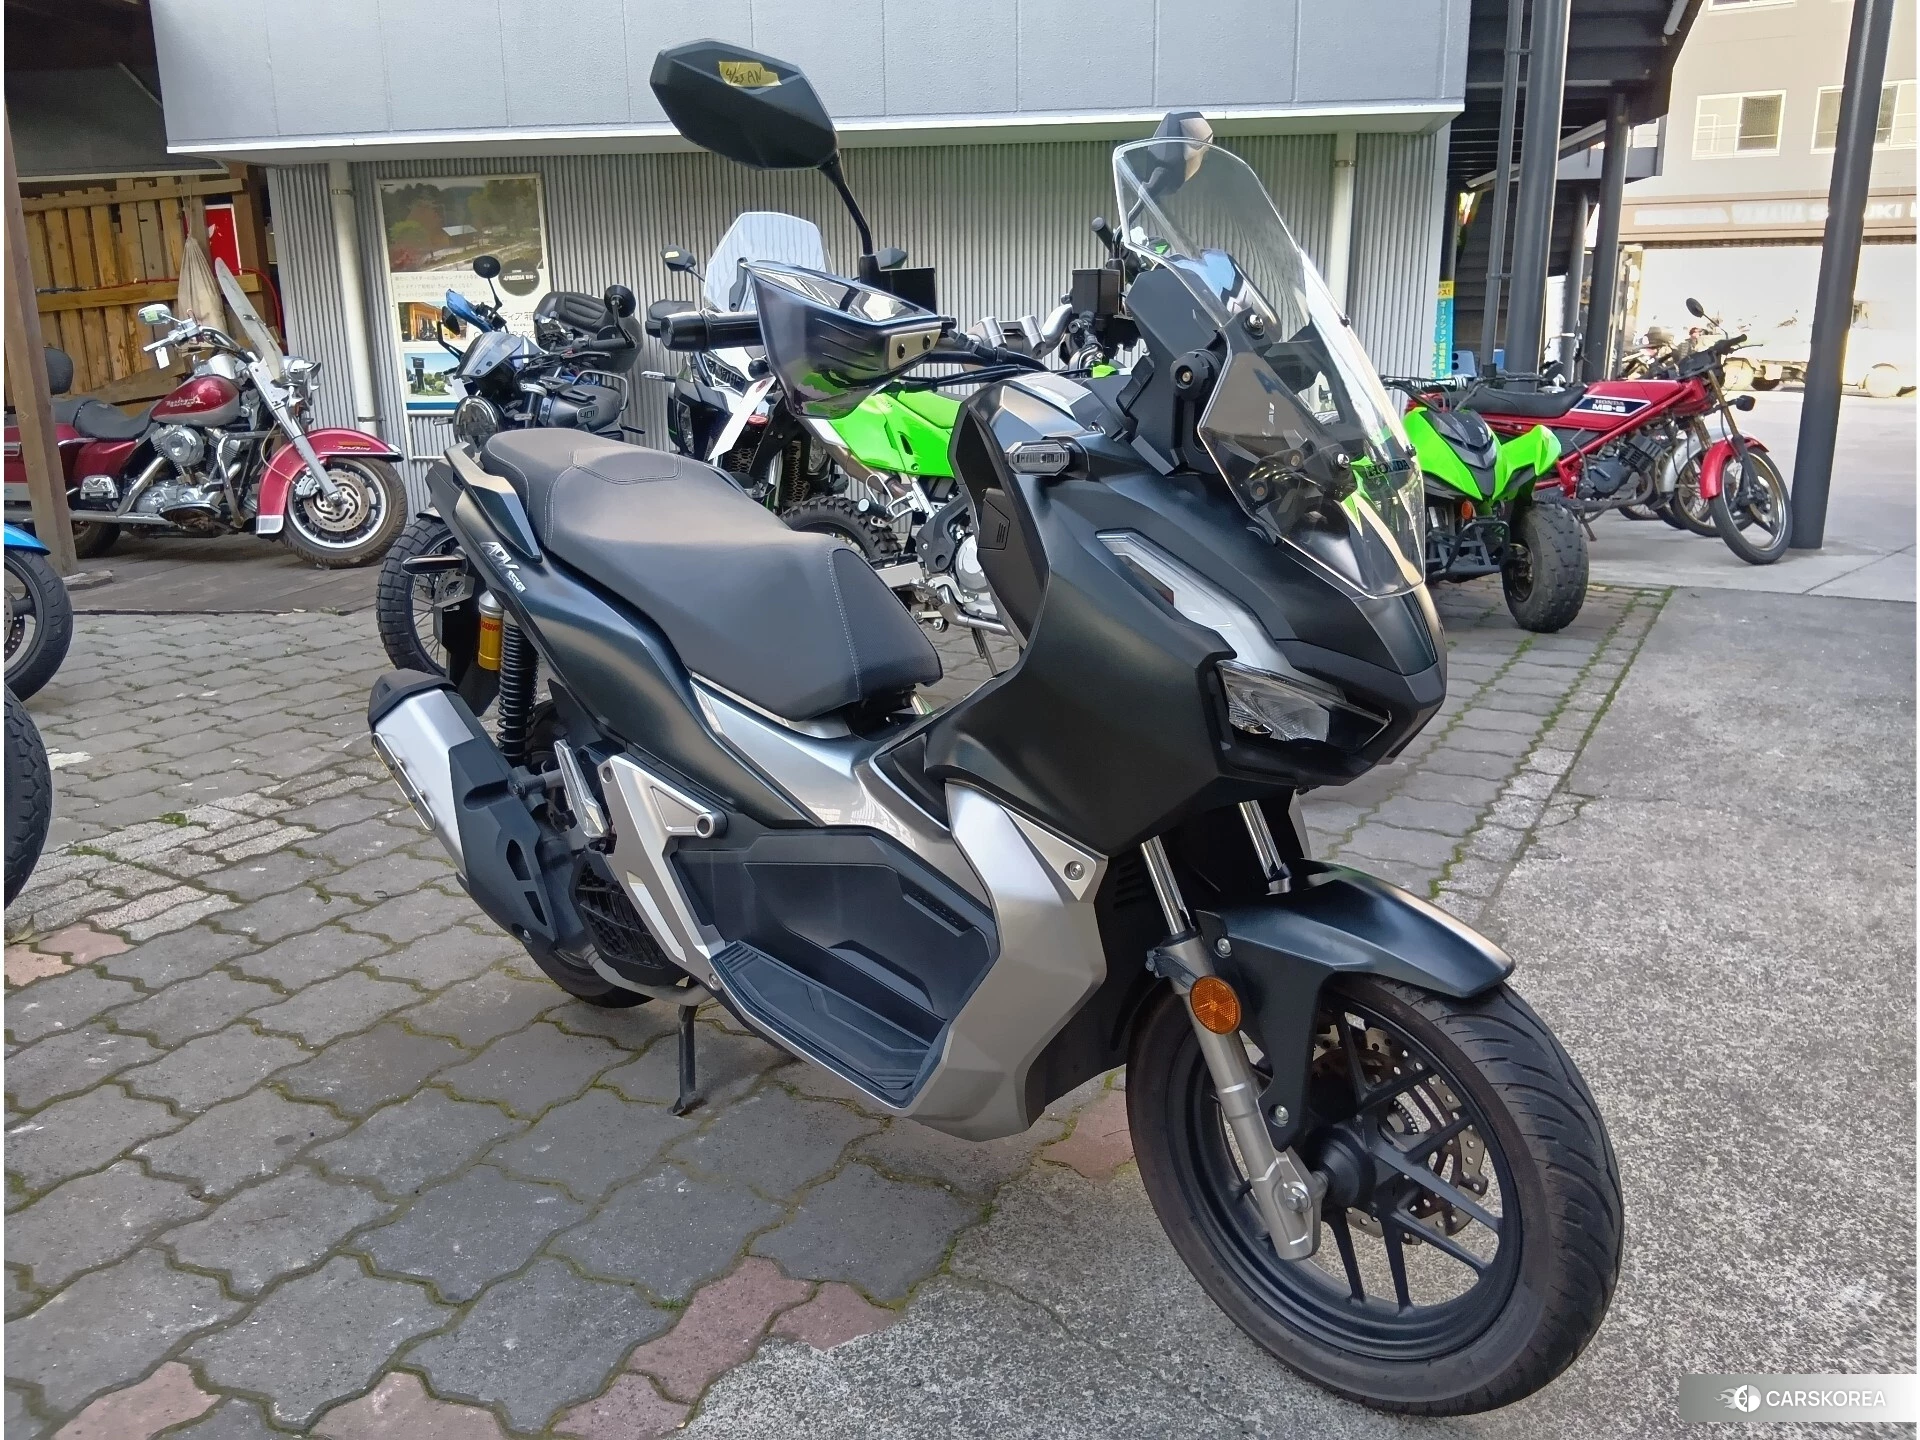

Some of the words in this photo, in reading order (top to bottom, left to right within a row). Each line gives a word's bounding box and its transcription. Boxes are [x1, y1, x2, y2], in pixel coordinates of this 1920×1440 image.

[580, 410, 595, 419] 401
[1366, 459, 1411, 477] HONDA
[480, 541, 519, 571] ADV
